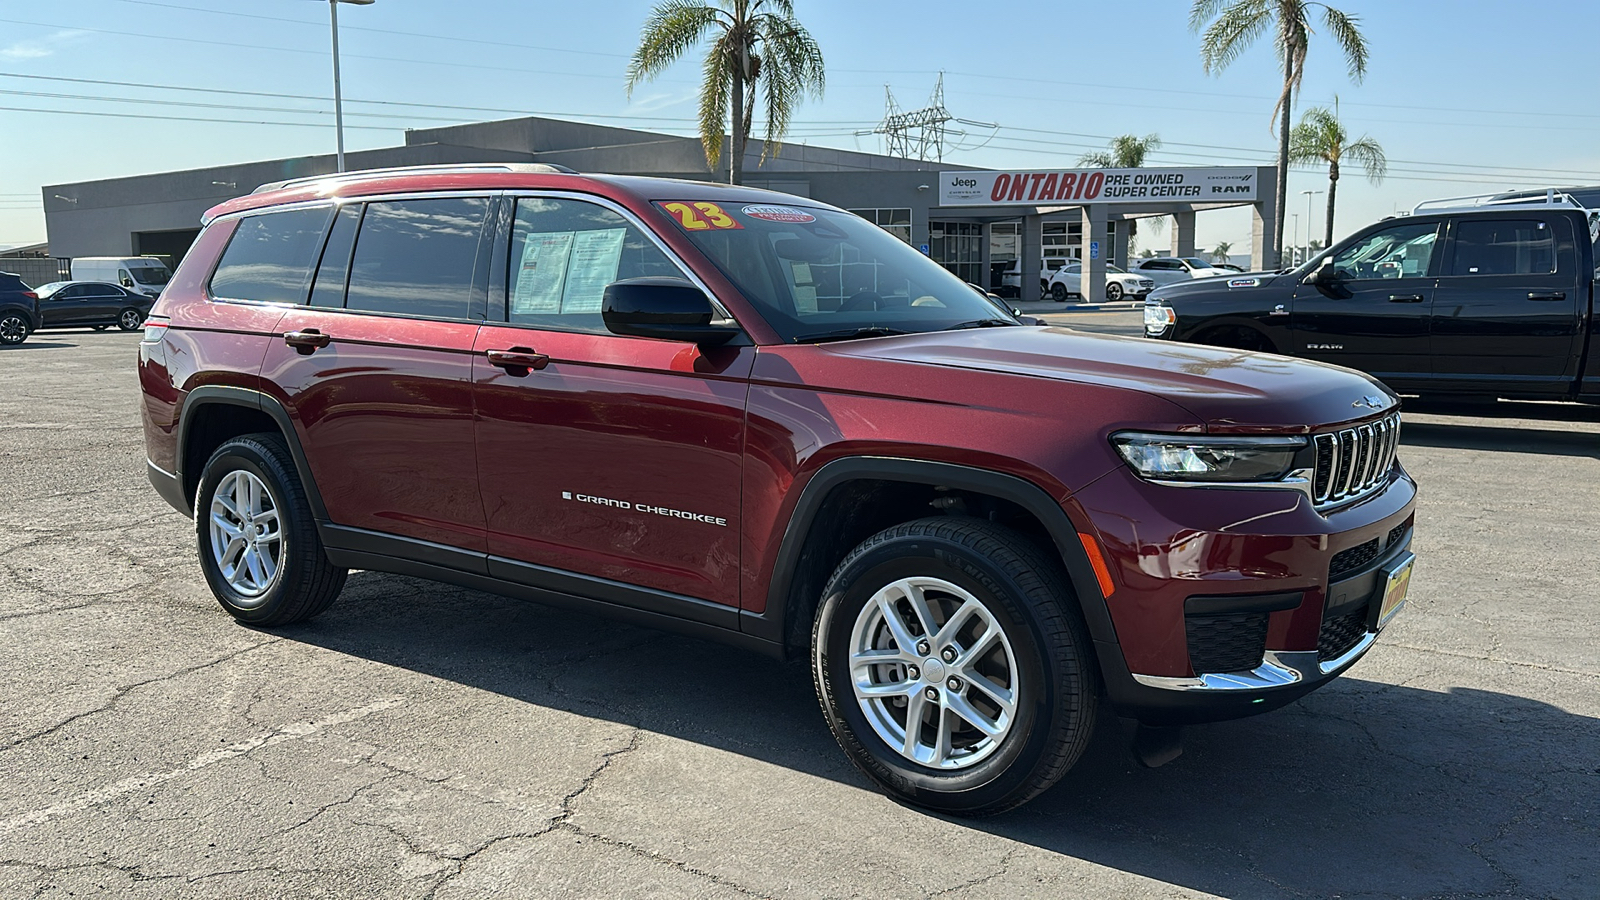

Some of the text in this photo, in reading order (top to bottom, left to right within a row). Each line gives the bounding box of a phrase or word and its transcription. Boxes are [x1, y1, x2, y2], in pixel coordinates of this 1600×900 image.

[951, 177, 977, 188] Jeep
[990, 172, 1105, 202] ONTARIO
[1104, 174, 1183, 186] PRE OWNED
[1104, 186, 1201, 198] SUPER CENTER
[664, 202, 736, 230] 23
[576, 494, 727, 526] GRAND CHEROKEE
